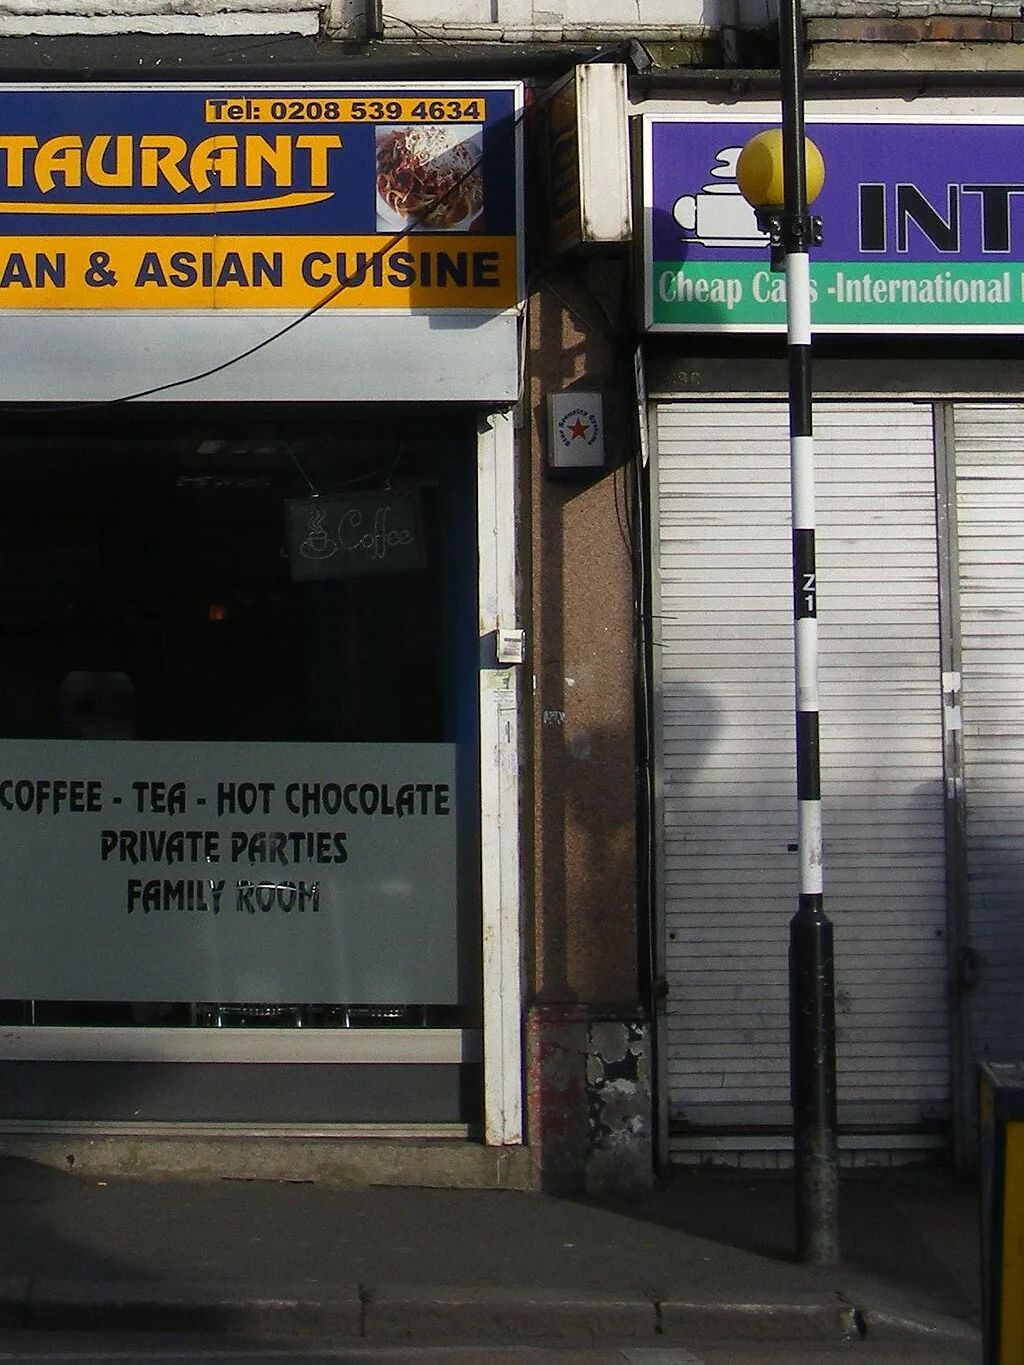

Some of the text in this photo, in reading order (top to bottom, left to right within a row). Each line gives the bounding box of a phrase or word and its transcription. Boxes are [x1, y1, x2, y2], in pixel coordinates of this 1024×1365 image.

[209, 99, 480, 120] Tel: 0208 539 4634
[85, 250, 118, 287] &
[135, 251, 284, 287] ASIAN
[301, 251, 500, 287] CUISINE
[658, 271, 743, 309] Cheap
[752, 271, 818, 304] Cas
[337, 506, 415, 559] Coffee
[0, 780, 103, 816] COFFEE
[132, 781, 187, 817] TEA
[217, 782, 276, 817] HOT
[285, 783, 451, 819] CHOCOLATE
[100, 830, 349, 866] PRIVATE PARTIES
[127, 879, 321, 915] FAMILY ROOM
